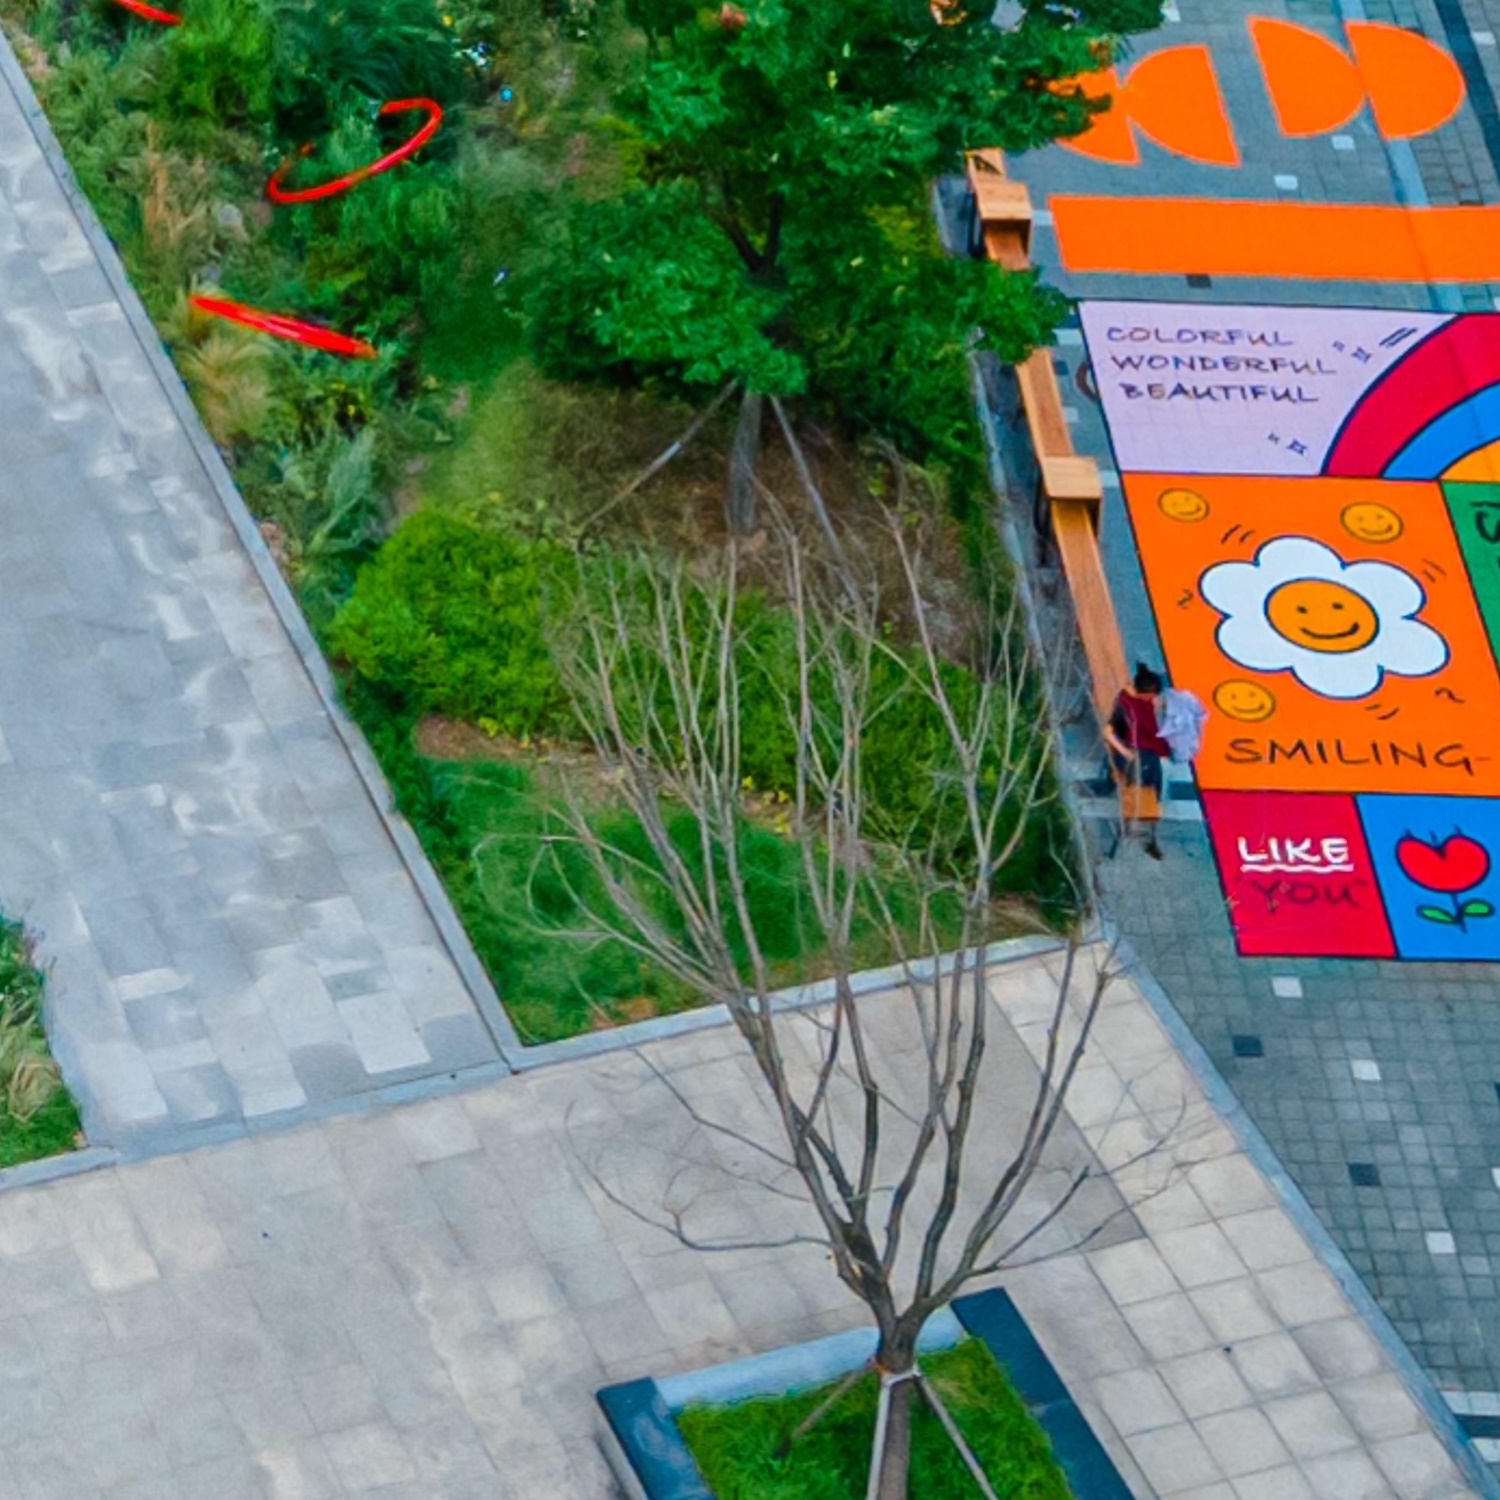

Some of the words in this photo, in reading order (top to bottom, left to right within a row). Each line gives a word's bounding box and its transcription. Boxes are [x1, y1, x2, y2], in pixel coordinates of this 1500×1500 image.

[1105, 325, 1294, 348] COLORFUL
[1110, 353, 1339, 377] WONDERFUL
[1120, 381, 1322, 405] BEAUTIFUL
[1224, 737, 1478, 772] SMILING
[1236, 835, 1350, 866] LIKE
